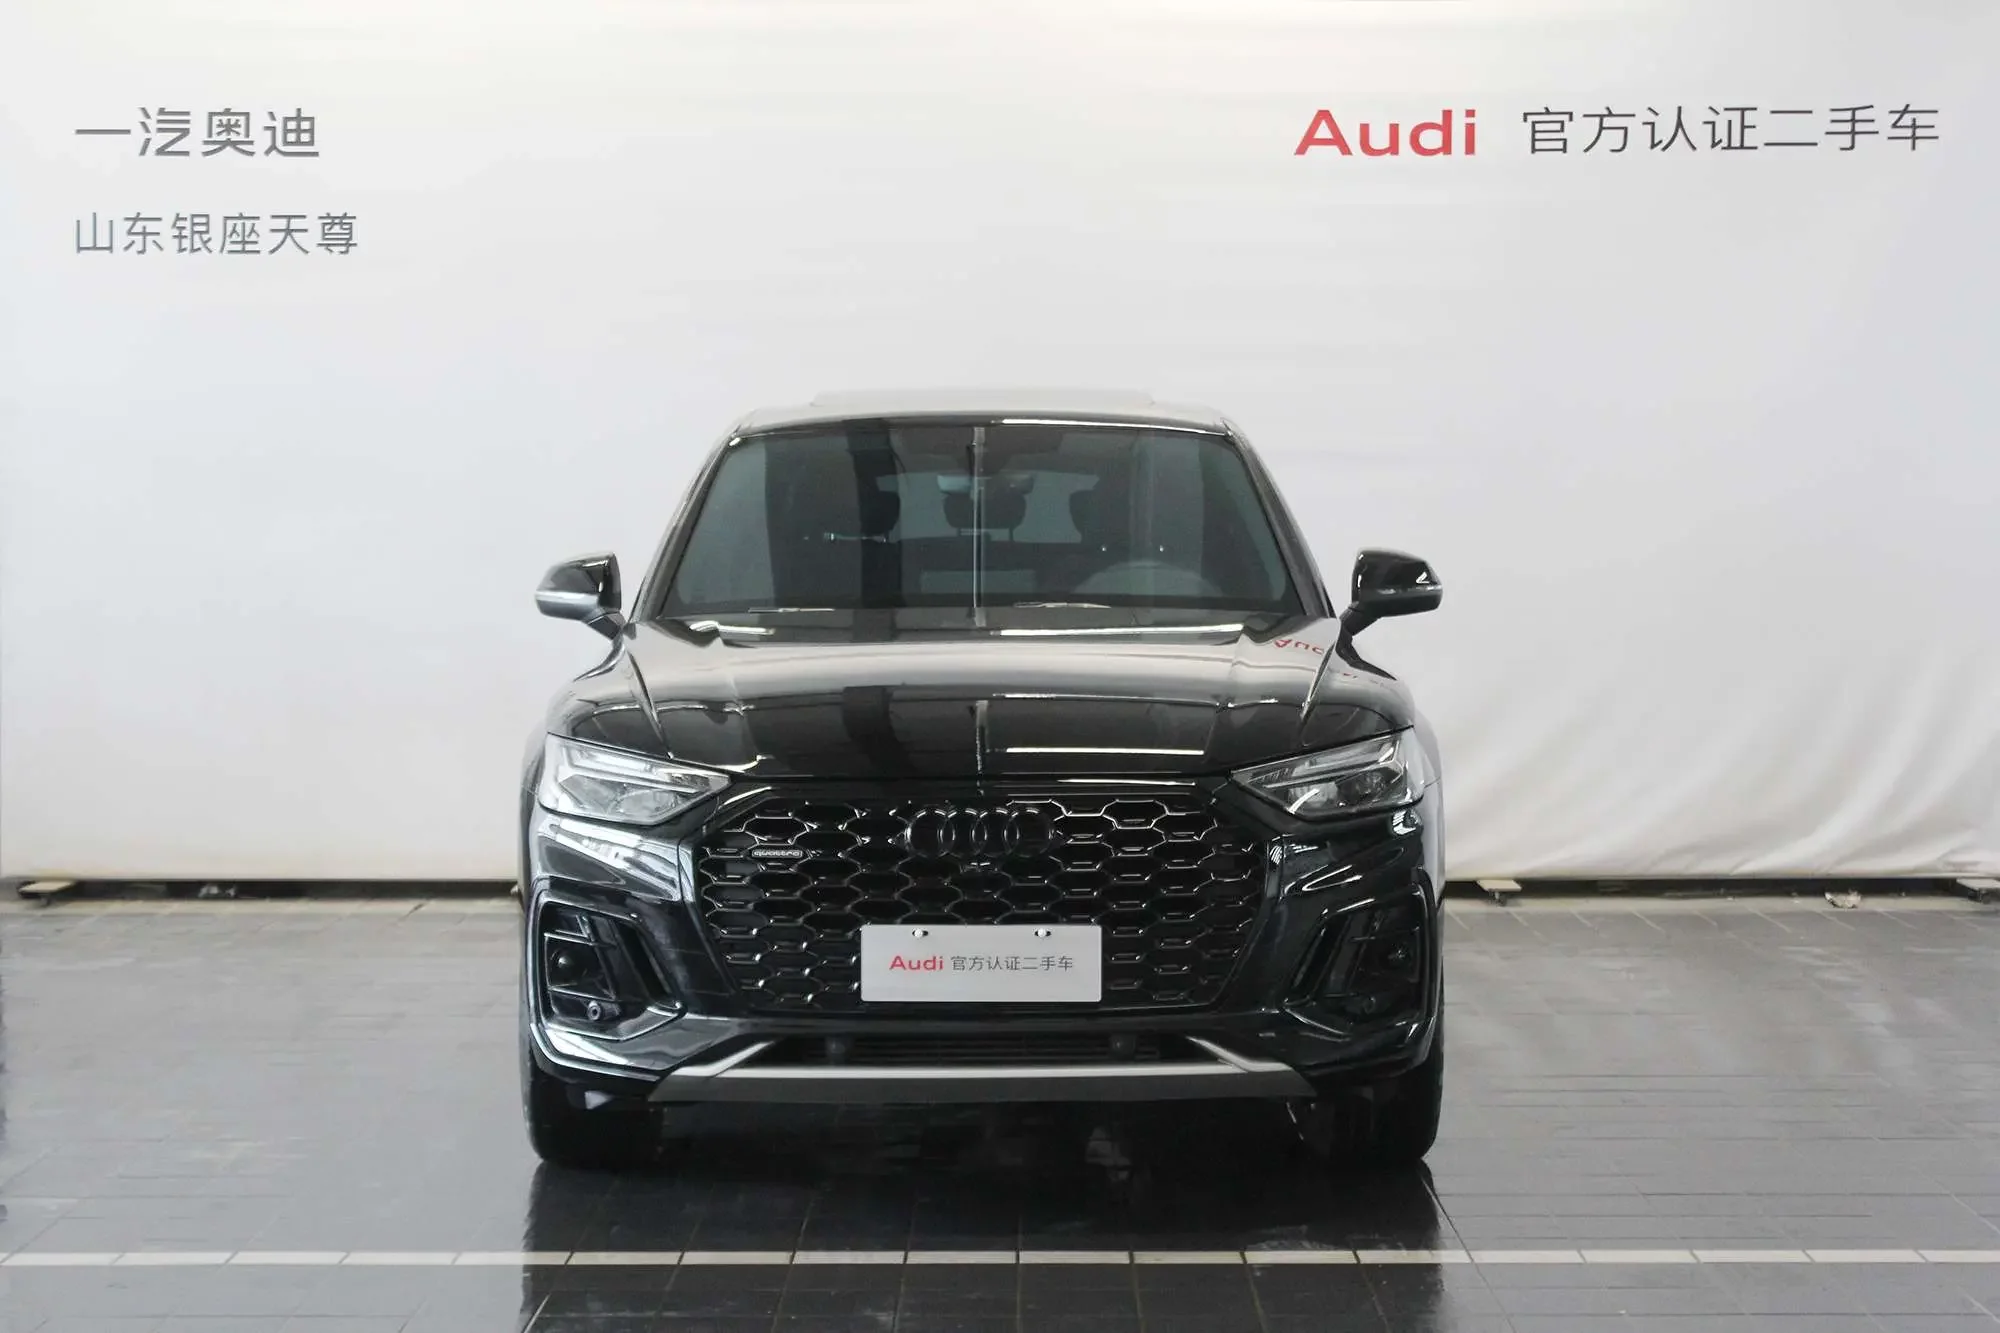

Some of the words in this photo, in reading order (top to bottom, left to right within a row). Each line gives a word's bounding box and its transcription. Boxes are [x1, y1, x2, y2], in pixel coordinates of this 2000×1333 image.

[75, 107, 319, 157] 一汽奥迪
[1294, 109, 1476, 156] Audi
[1523, 104, 1939, 154] 官方认证二手车
[76, 212, 357, 255] 山东银座天尊
[889, 956, 943, 971] Audi
[951, 956, 1072, 971] 官方认证二手车
